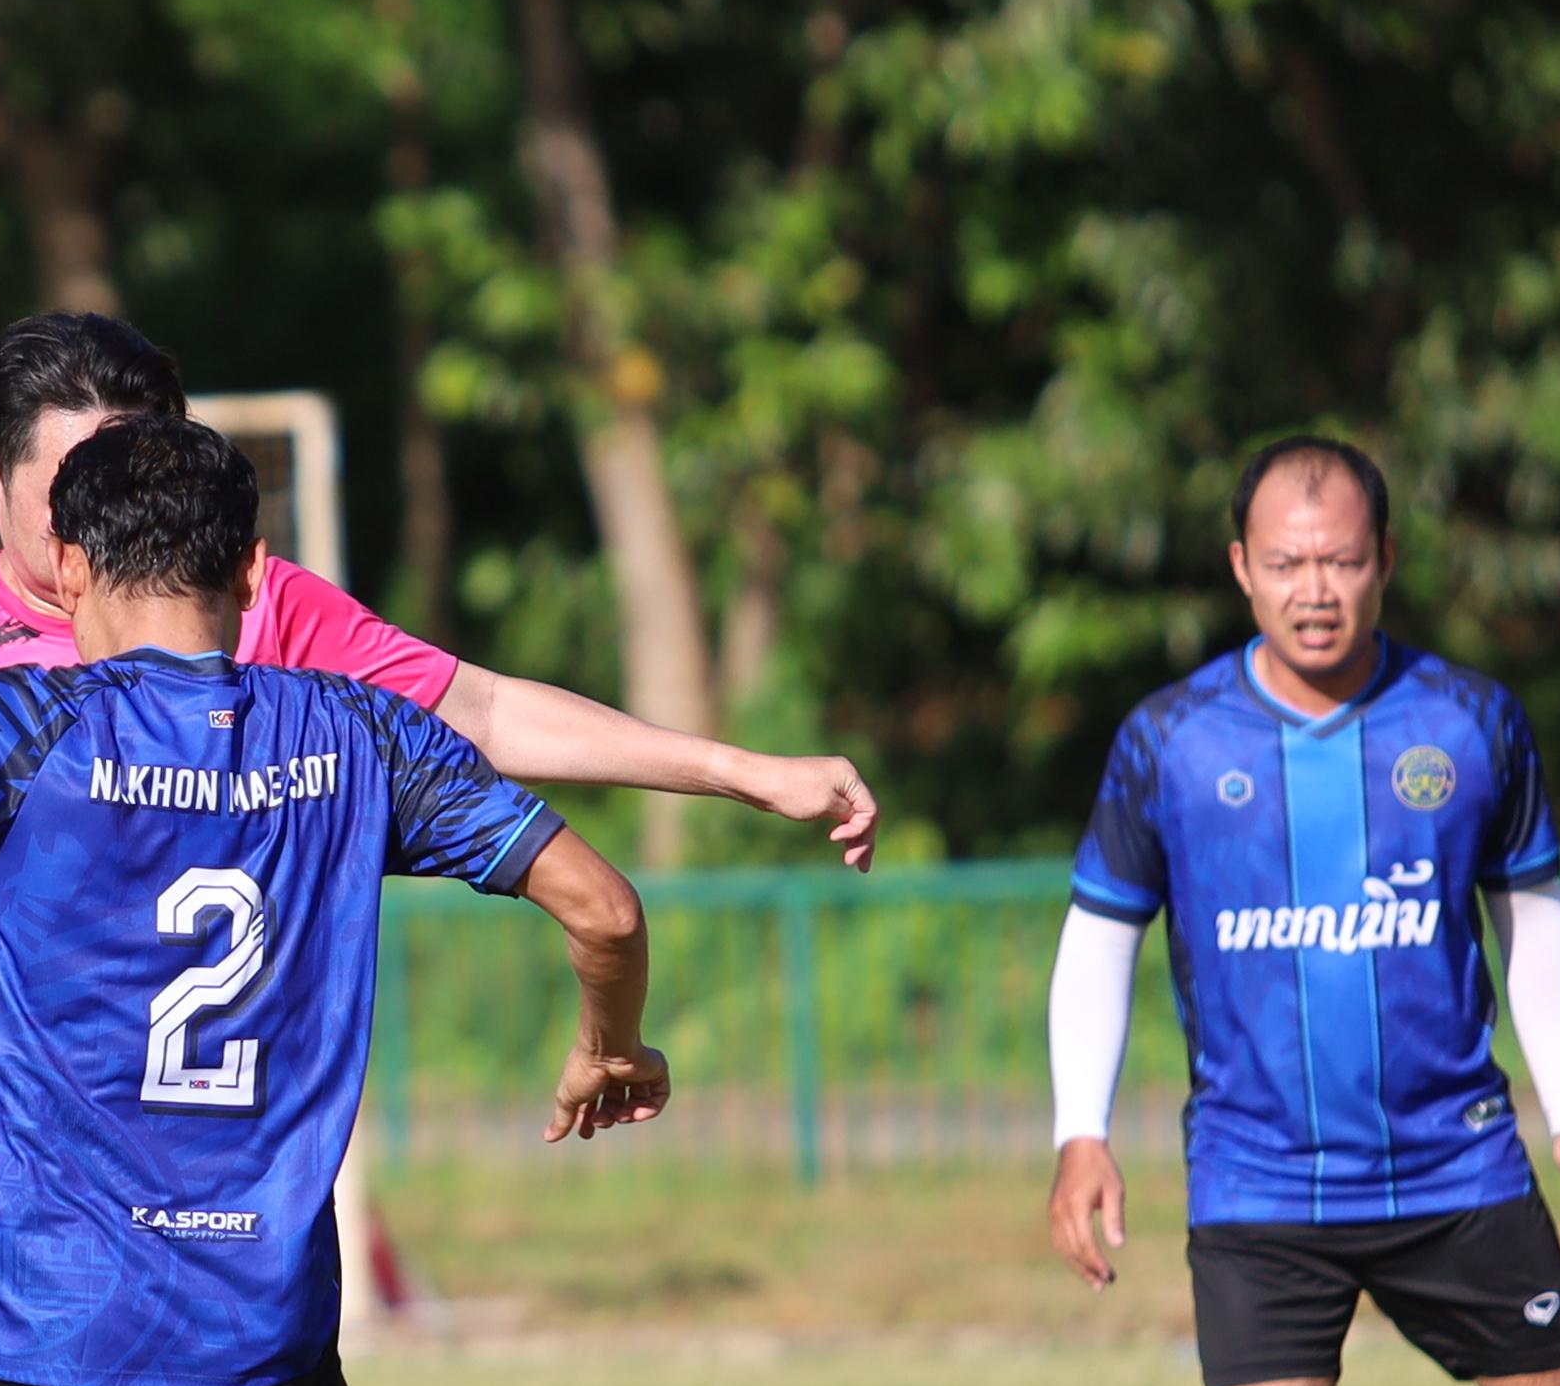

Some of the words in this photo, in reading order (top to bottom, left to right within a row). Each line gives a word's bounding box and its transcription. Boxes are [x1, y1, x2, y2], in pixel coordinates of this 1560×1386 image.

[90, 756, 218, 811] NAKHON
[229, 764, 282, 813] MAE
[288, 753, 337, 800] SOT
[140, 867, 265, 1106] 2
[131, 1206, 257, 1231] K.A.SPORT
